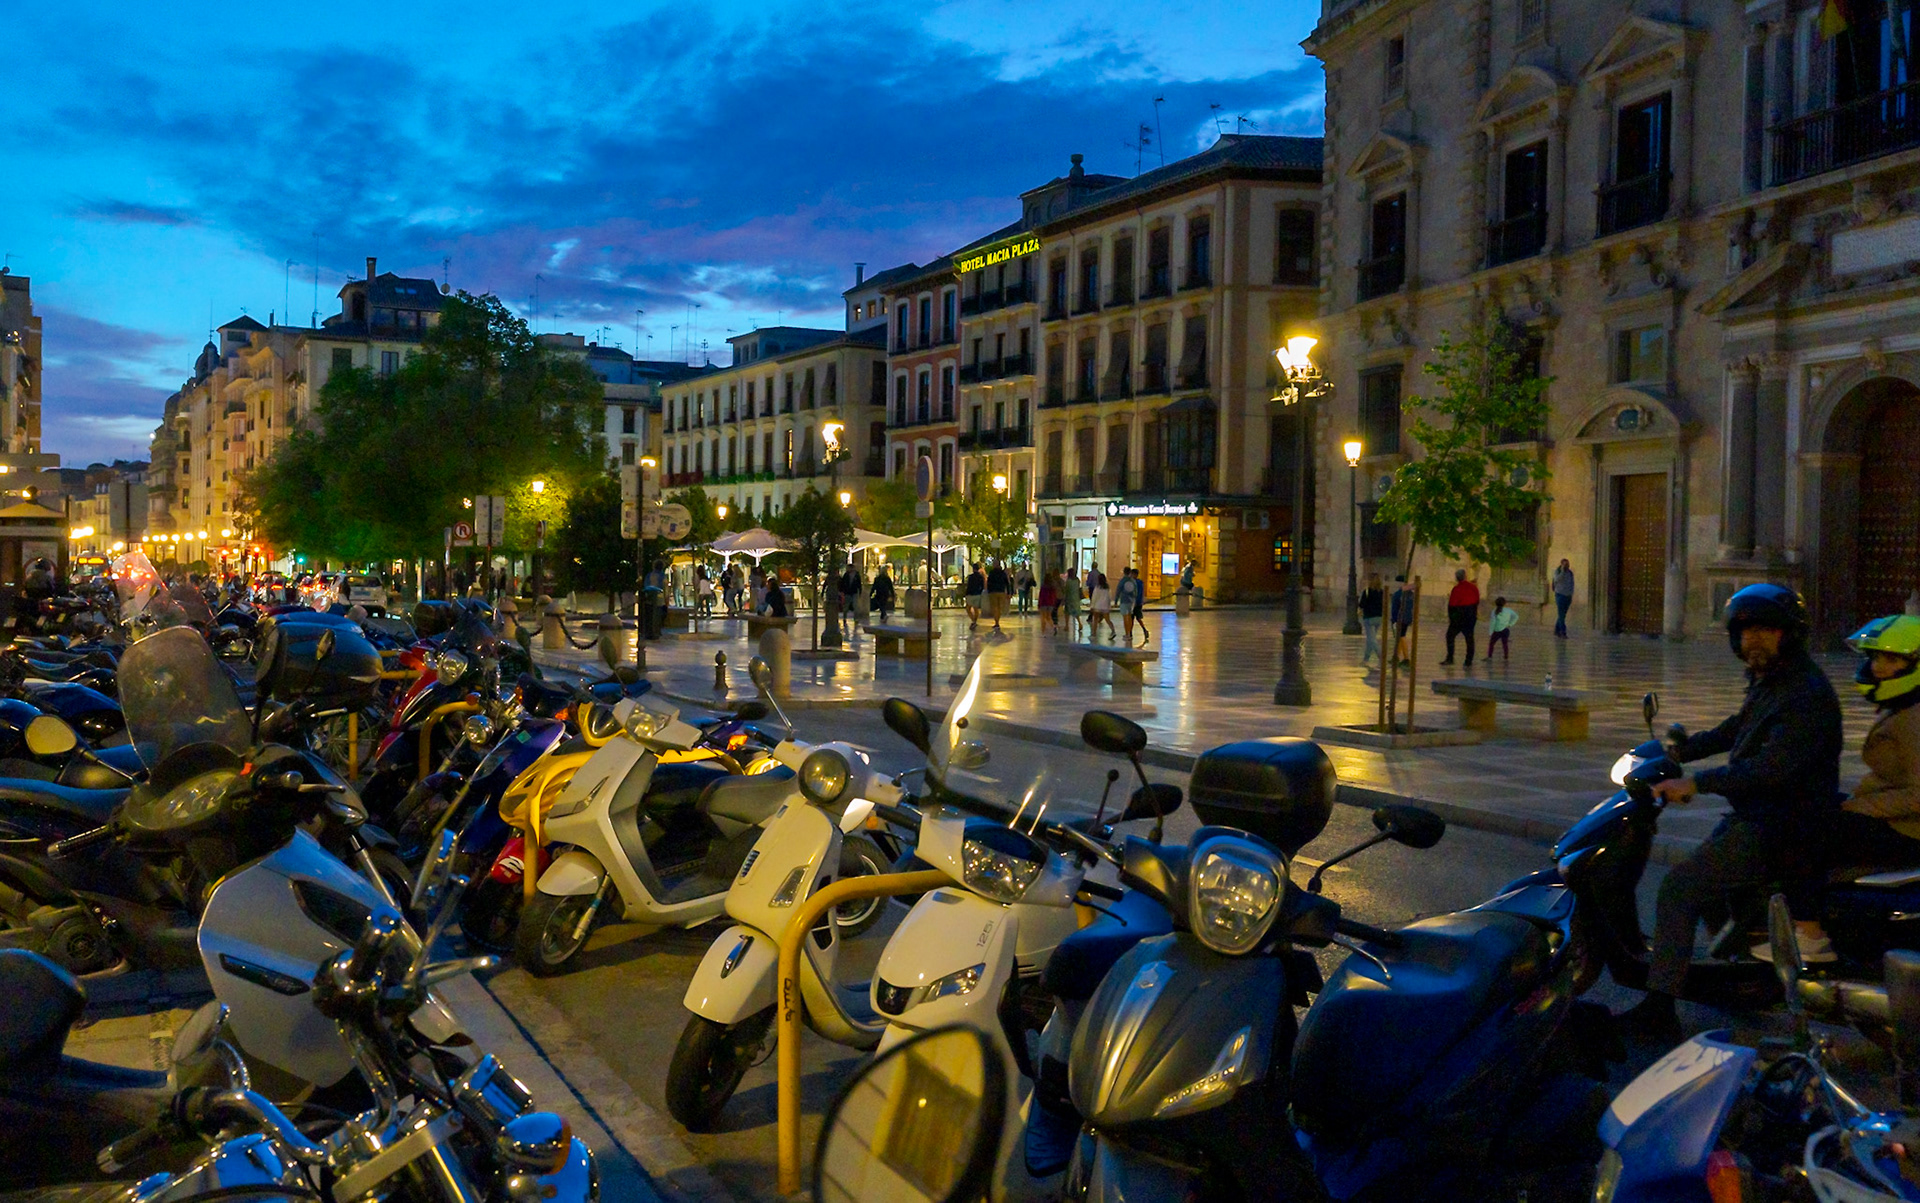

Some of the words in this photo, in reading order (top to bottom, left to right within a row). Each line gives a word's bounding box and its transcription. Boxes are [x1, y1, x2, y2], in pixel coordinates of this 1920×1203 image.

[961, 256, 985, 273] HOTEL
[987, 248, 1010, 265] MACIA
[1012, 240, 1039, 258] PLAZA
